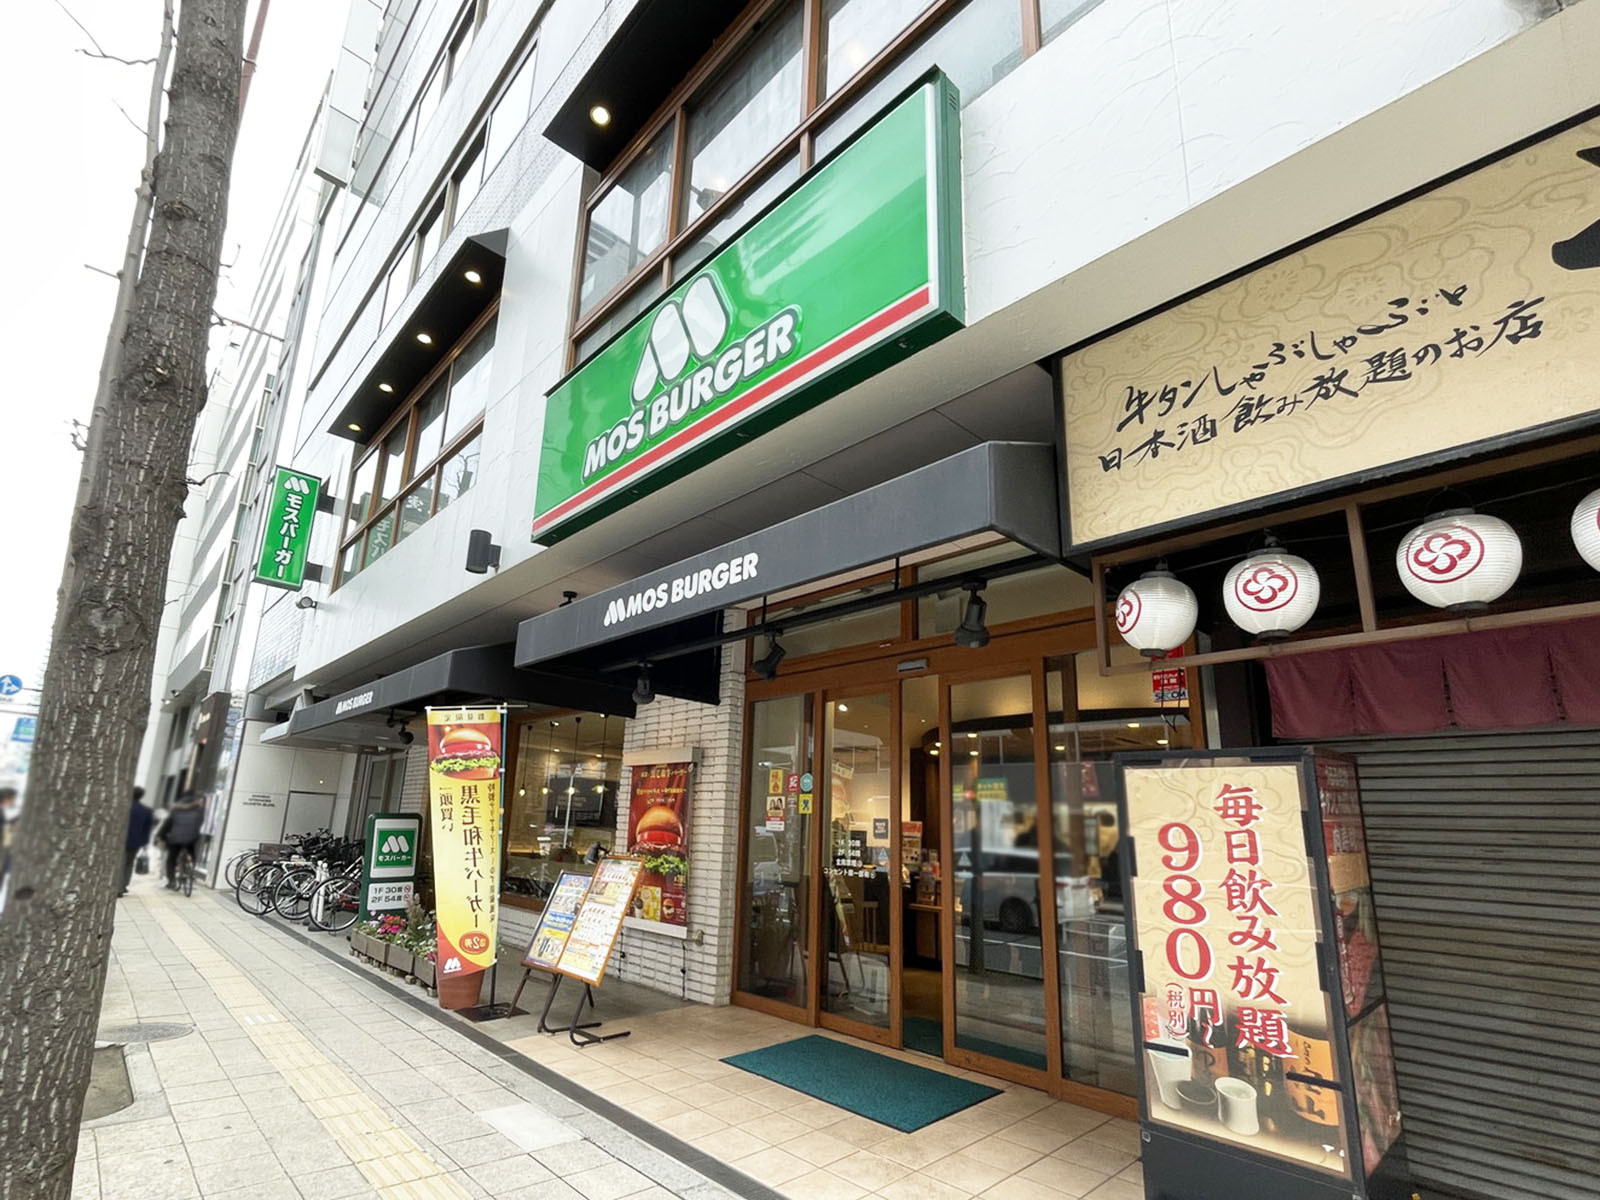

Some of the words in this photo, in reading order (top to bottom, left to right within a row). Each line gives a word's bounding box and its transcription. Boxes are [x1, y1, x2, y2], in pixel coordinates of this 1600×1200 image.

[583, 410, 645, 478] MOS
[650, 313, 794, 435] BURGER
[1098, 296, 1546, 473] 日本酒飲み放題のお店
[1116, 284, 1468, 433] 牛タンしゃぶしゃぶと
[274, 493, 303, 578] モスバーガー
[626, 582, 669, 618] MOS
[671, 552, 759, 604] BURGER
[378, 854, 412, 862] モスバーガー
[1213, 783, 1300, 1059] 毎日飲み放題
